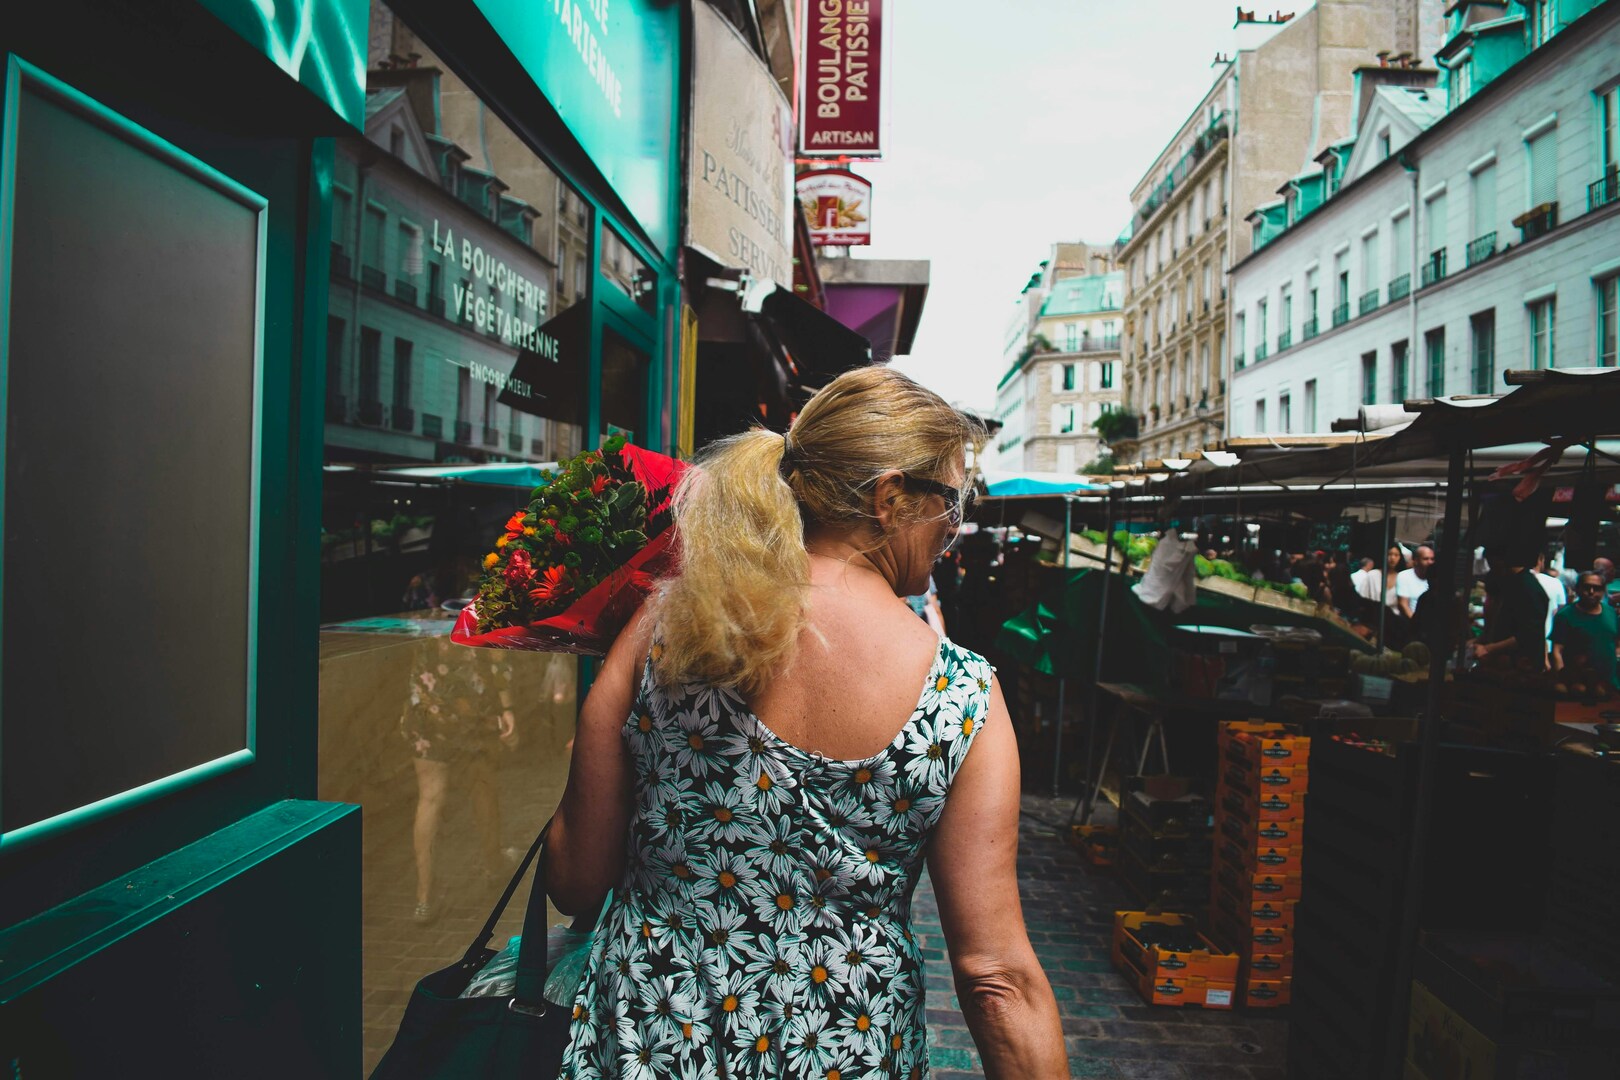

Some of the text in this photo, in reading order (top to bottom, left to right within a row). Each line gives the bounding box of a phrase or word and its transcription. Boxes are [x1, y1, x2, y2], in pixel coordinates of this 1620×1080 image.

[817, 0, 842, 118] BOULANG
[845, 0, 869, 101] PATISSIE
[810, 131, 874, 144] ARTISAN
[433, 219, 548, 316] LA BOUCHERIE
[453, 282, 559, 363] VÉGÉTARIENNE
[469, 360, 532, 398] ENCORE MIEUX
